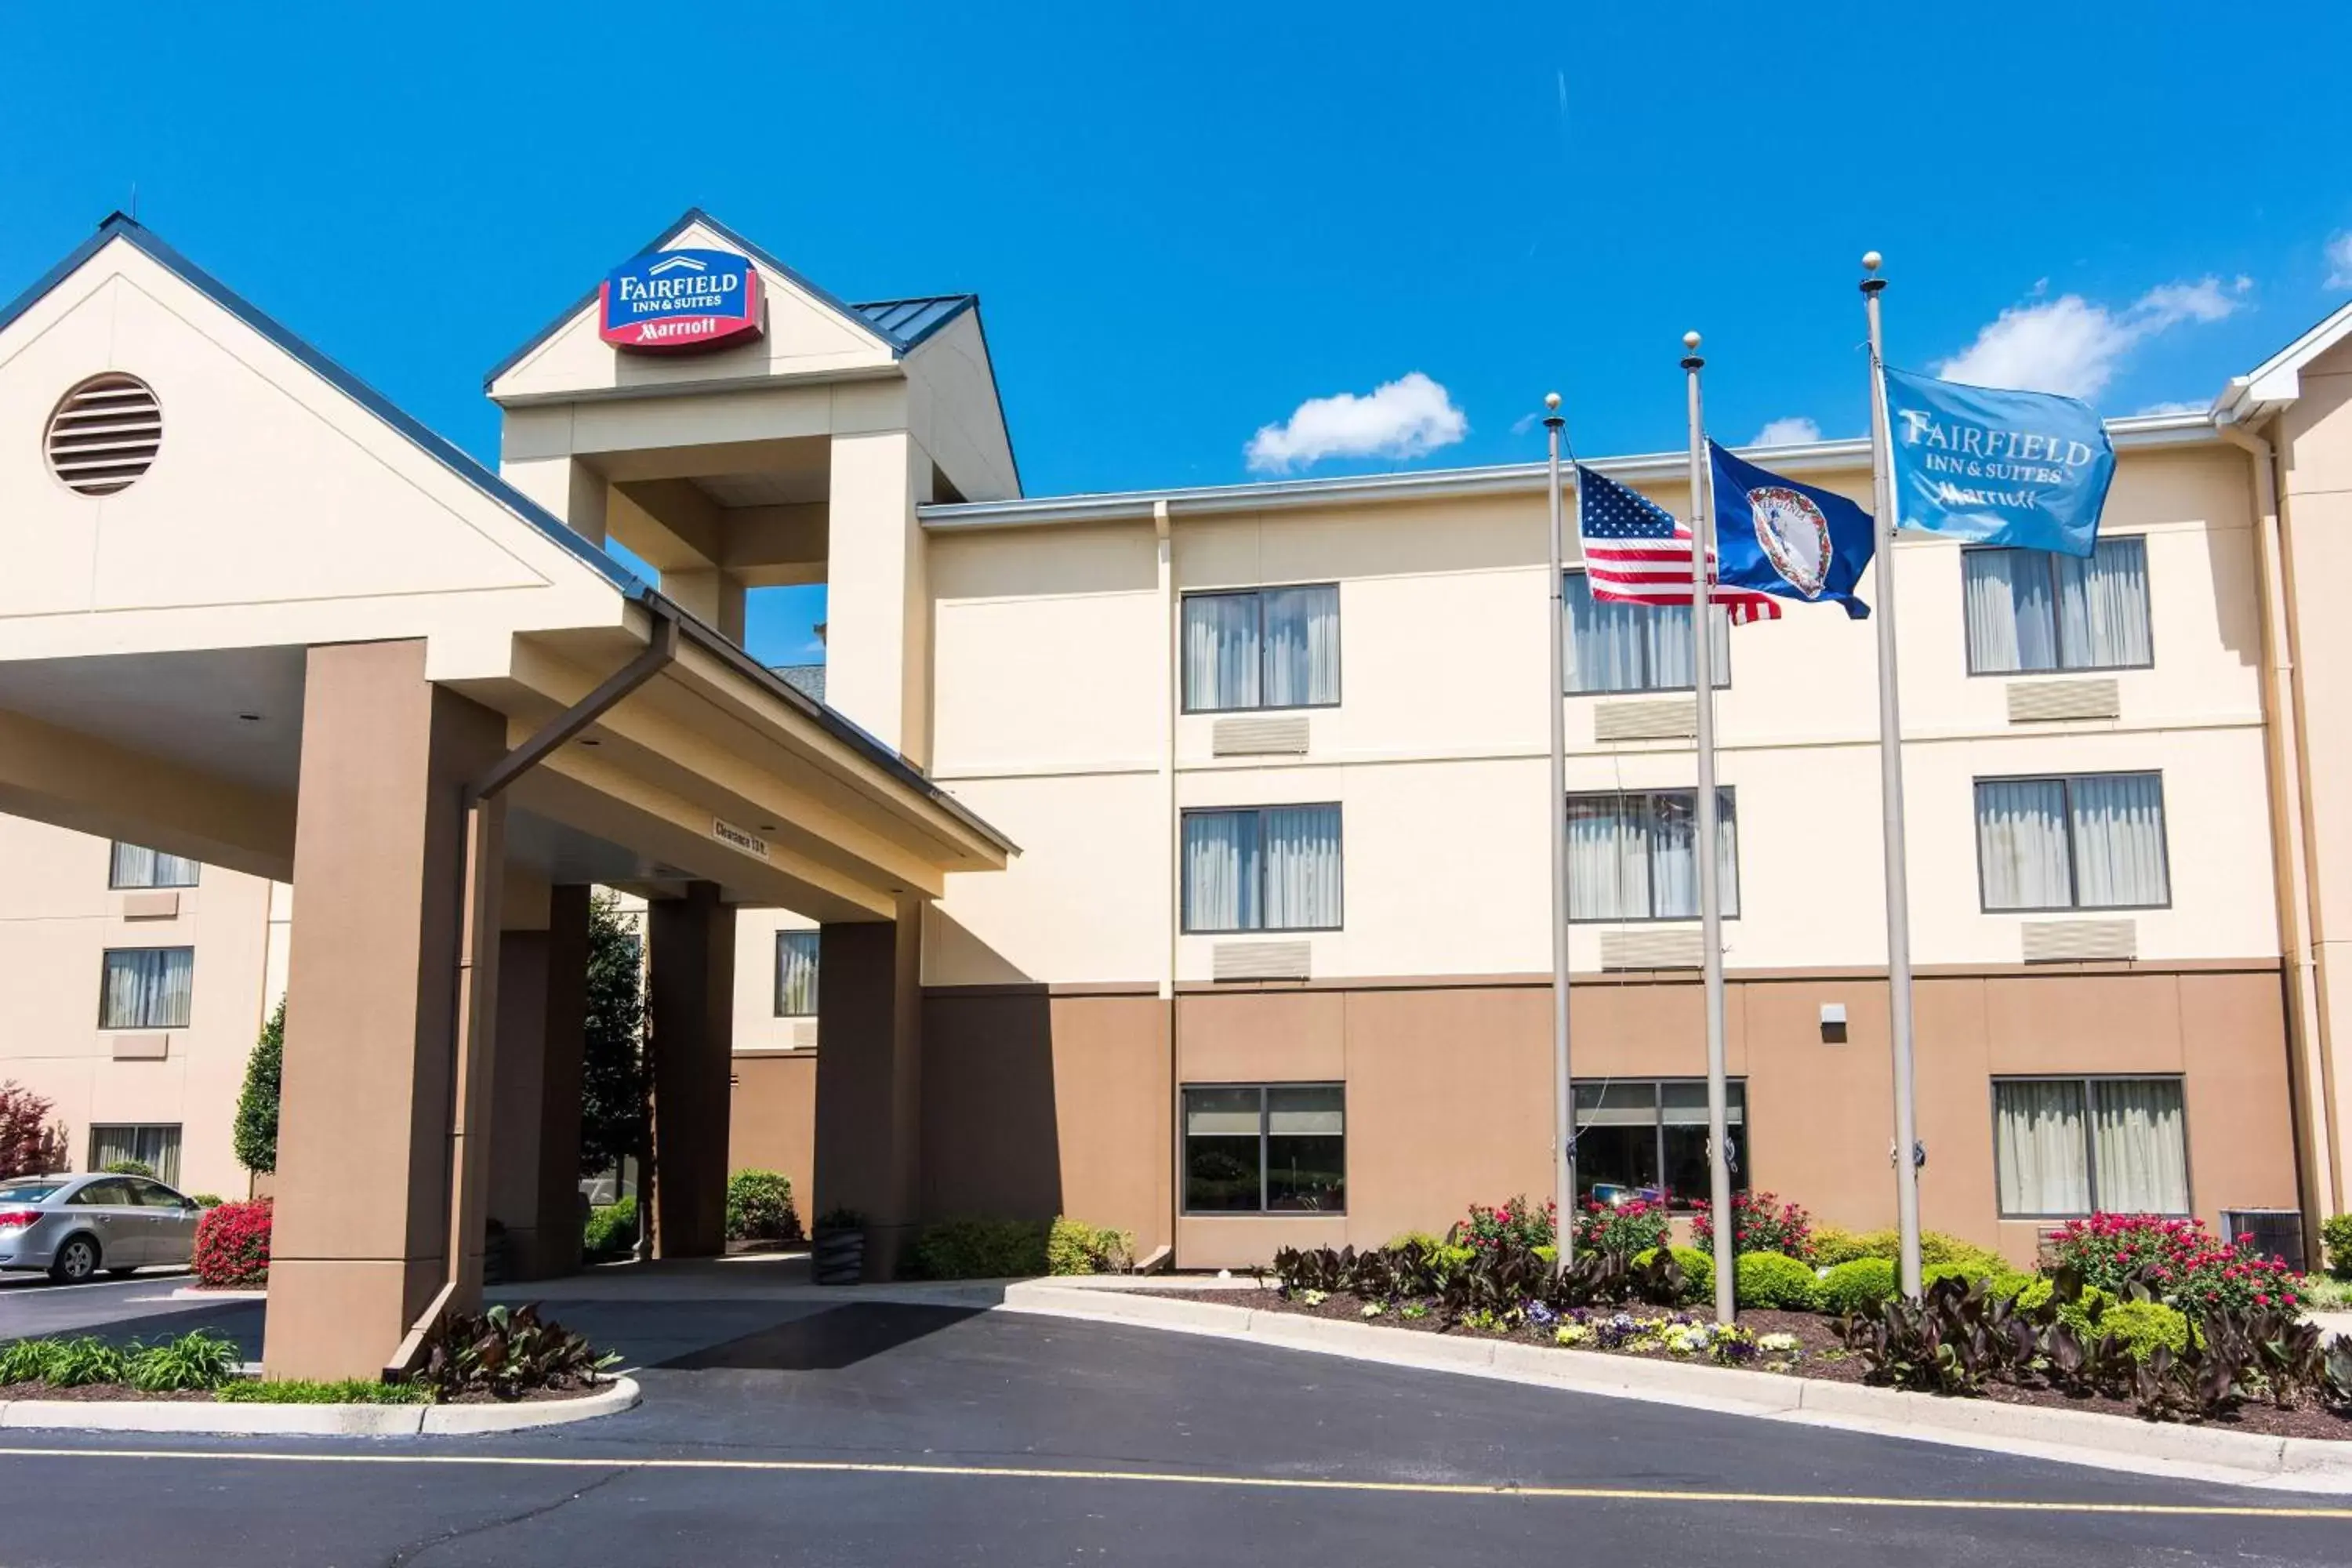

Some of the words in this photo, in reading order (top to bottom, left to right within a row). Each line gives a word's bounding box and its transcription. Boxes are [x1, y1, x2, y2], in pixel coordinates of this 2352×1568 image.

[620, 274, 738, 300] FAIRFIELD
[633, 300, 659, 313] INN
[662, 299, 672, 310] &
[674, 296, 722, 309] SUITES
[636, 318, 715, 342] Marriott
[1898, 409, 2092, 466] FAIRFIELD
[1926, 454, 1965, 472] INN
[1967, 460, 1982, 477] &
[1985, 463, 2063, 484] SUITES
[716, 821, 750, 848] Clearance
